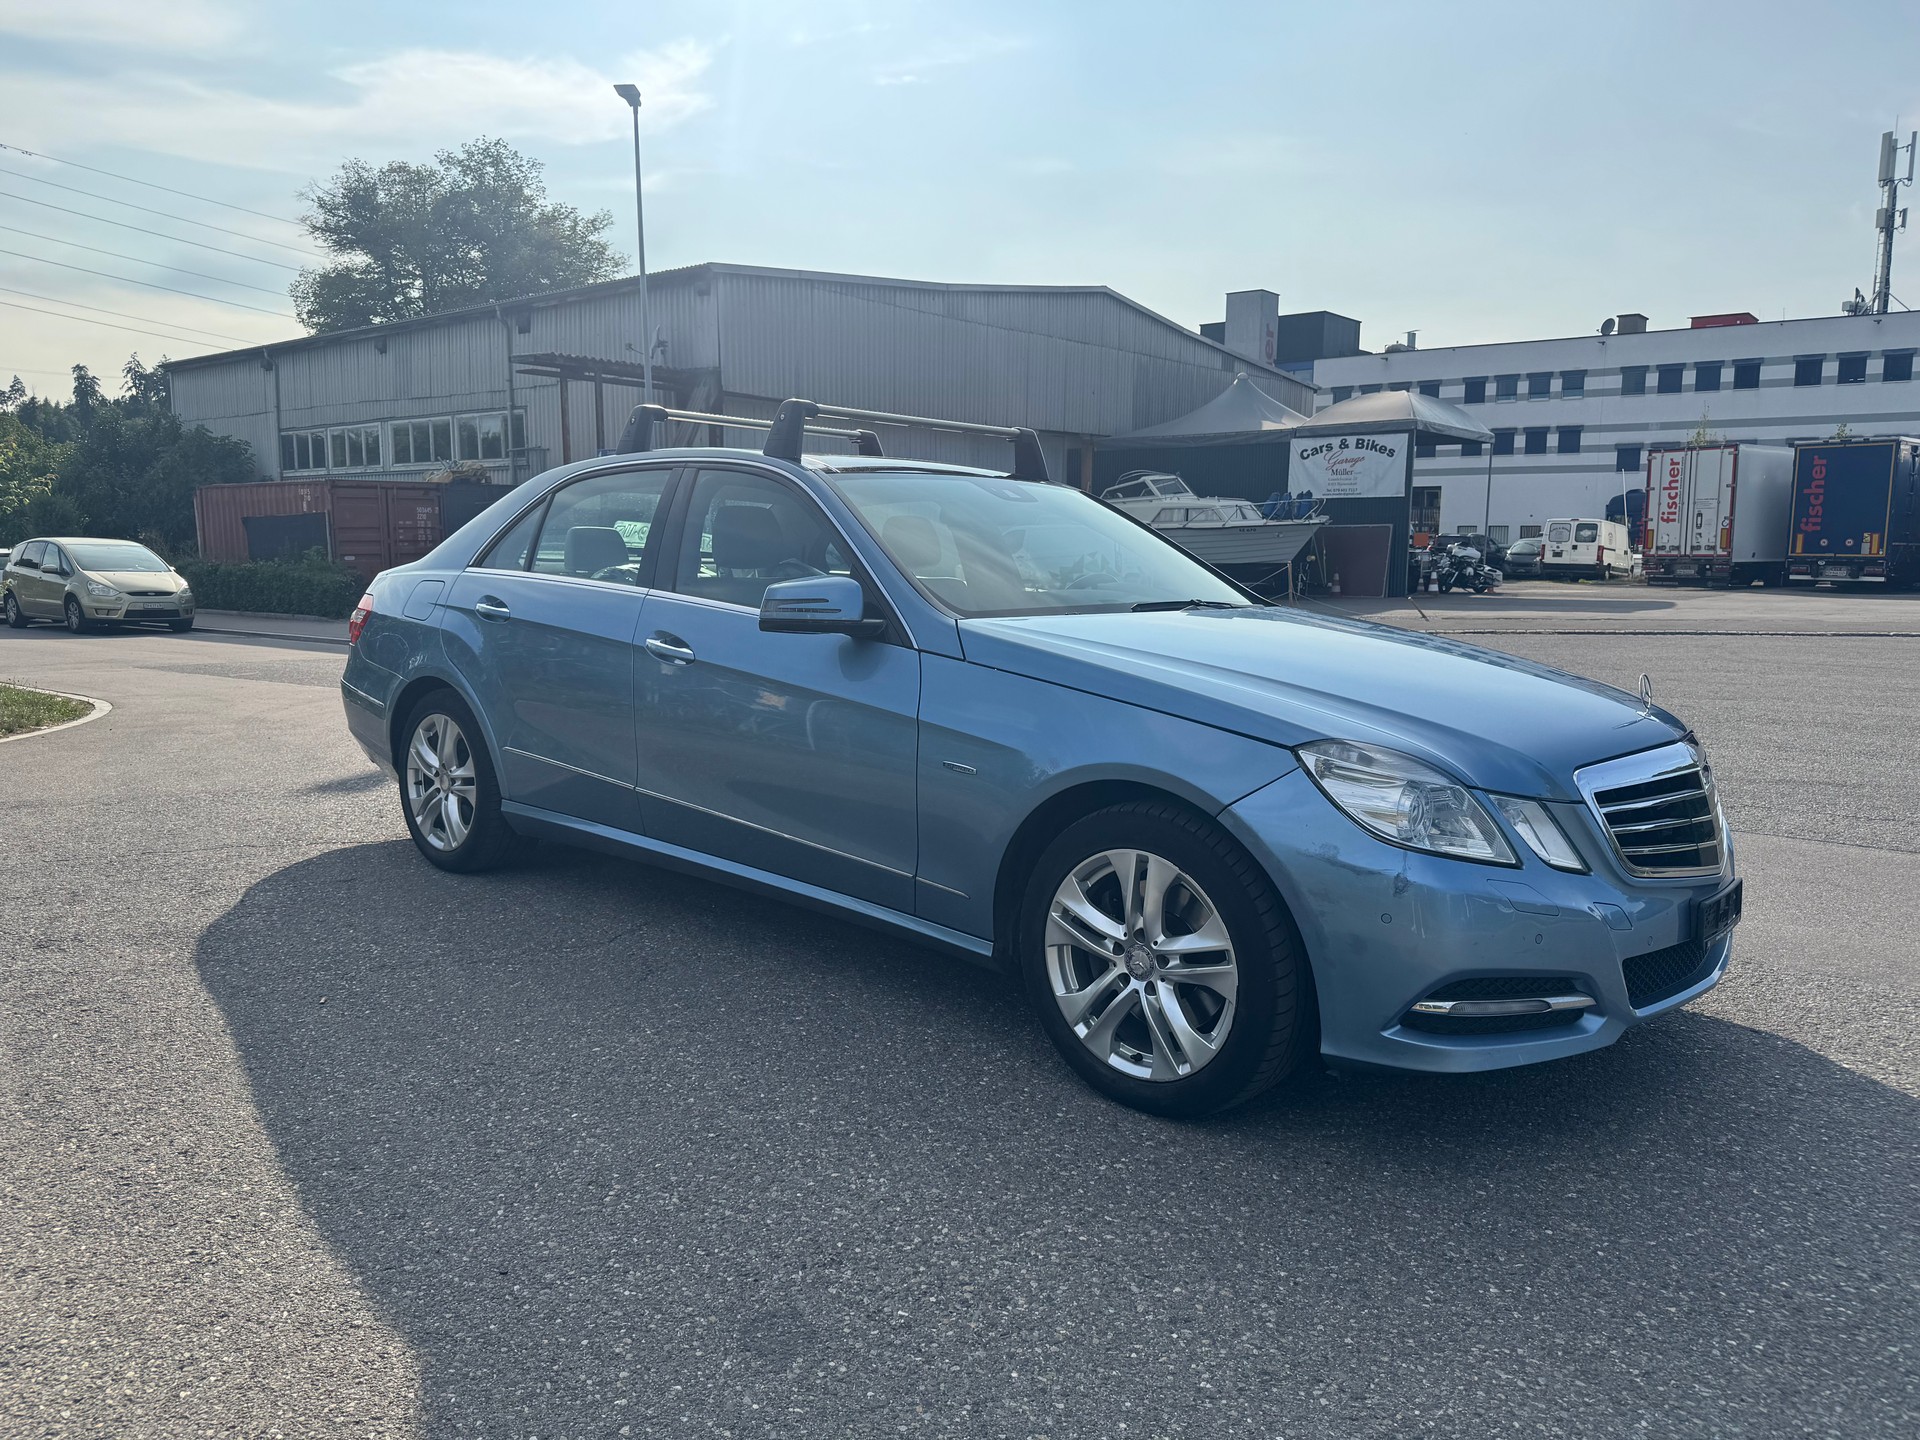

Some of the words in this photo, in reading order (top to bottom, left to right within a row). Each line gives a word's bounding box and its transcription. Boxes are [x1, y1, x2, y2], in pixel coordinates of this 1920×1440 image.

[1300, 443, 1333, 460] Cars
[1339, 438, 1350, 449] &
[1355, 438, 1396, 458] Bikes
[1324, 450, 1365, 471] Garage
[1331, 468, 1353, 476] Müller
[1661, 458, 1680, 523] fischer
[1800, 455, 1827, 532] fischer
